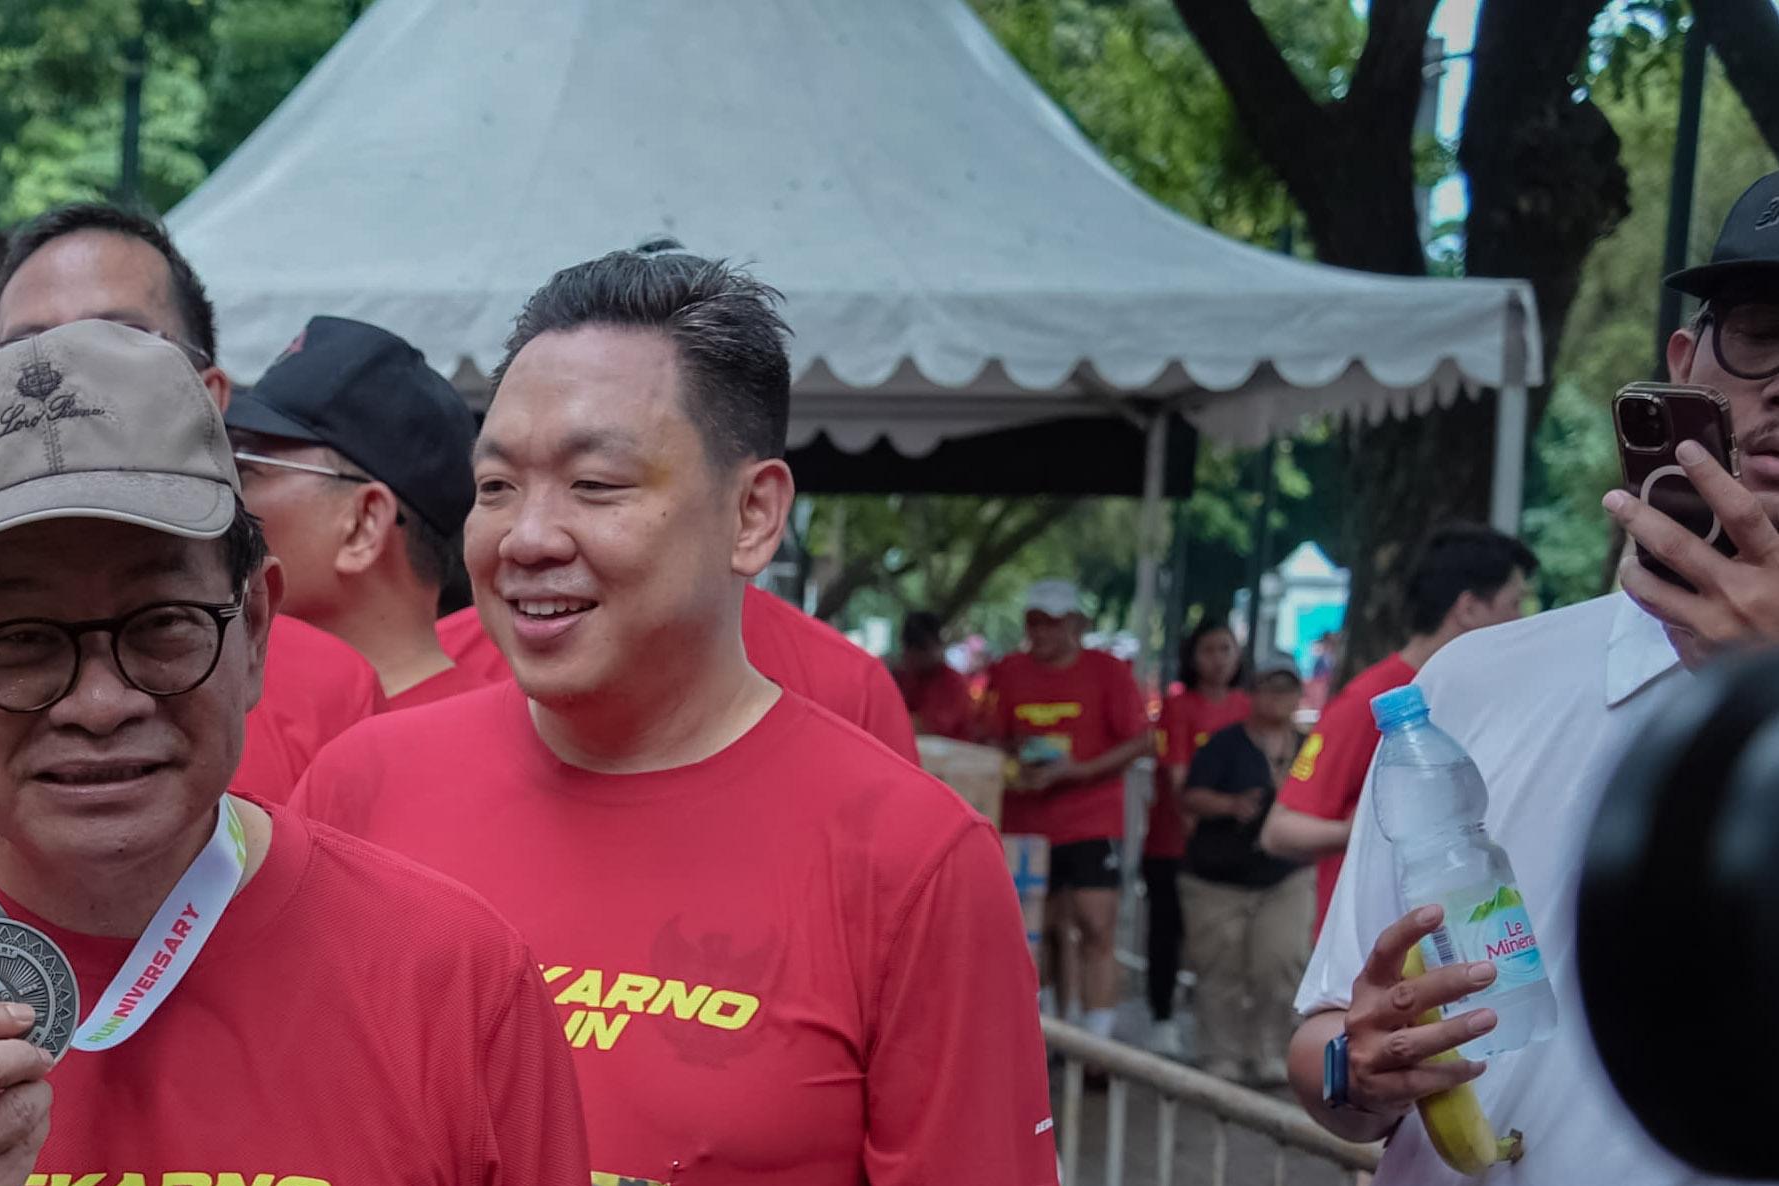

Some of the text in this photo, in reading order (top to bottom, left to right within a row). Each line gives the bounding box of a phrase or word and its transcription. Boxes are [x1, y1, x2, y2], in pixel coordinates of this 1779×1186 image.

[1504, 920, 1524, 938] Le
[1485, 934, 1537, 960] Minera
[87, 902, 202, 1044] RUNNIVERSARY
